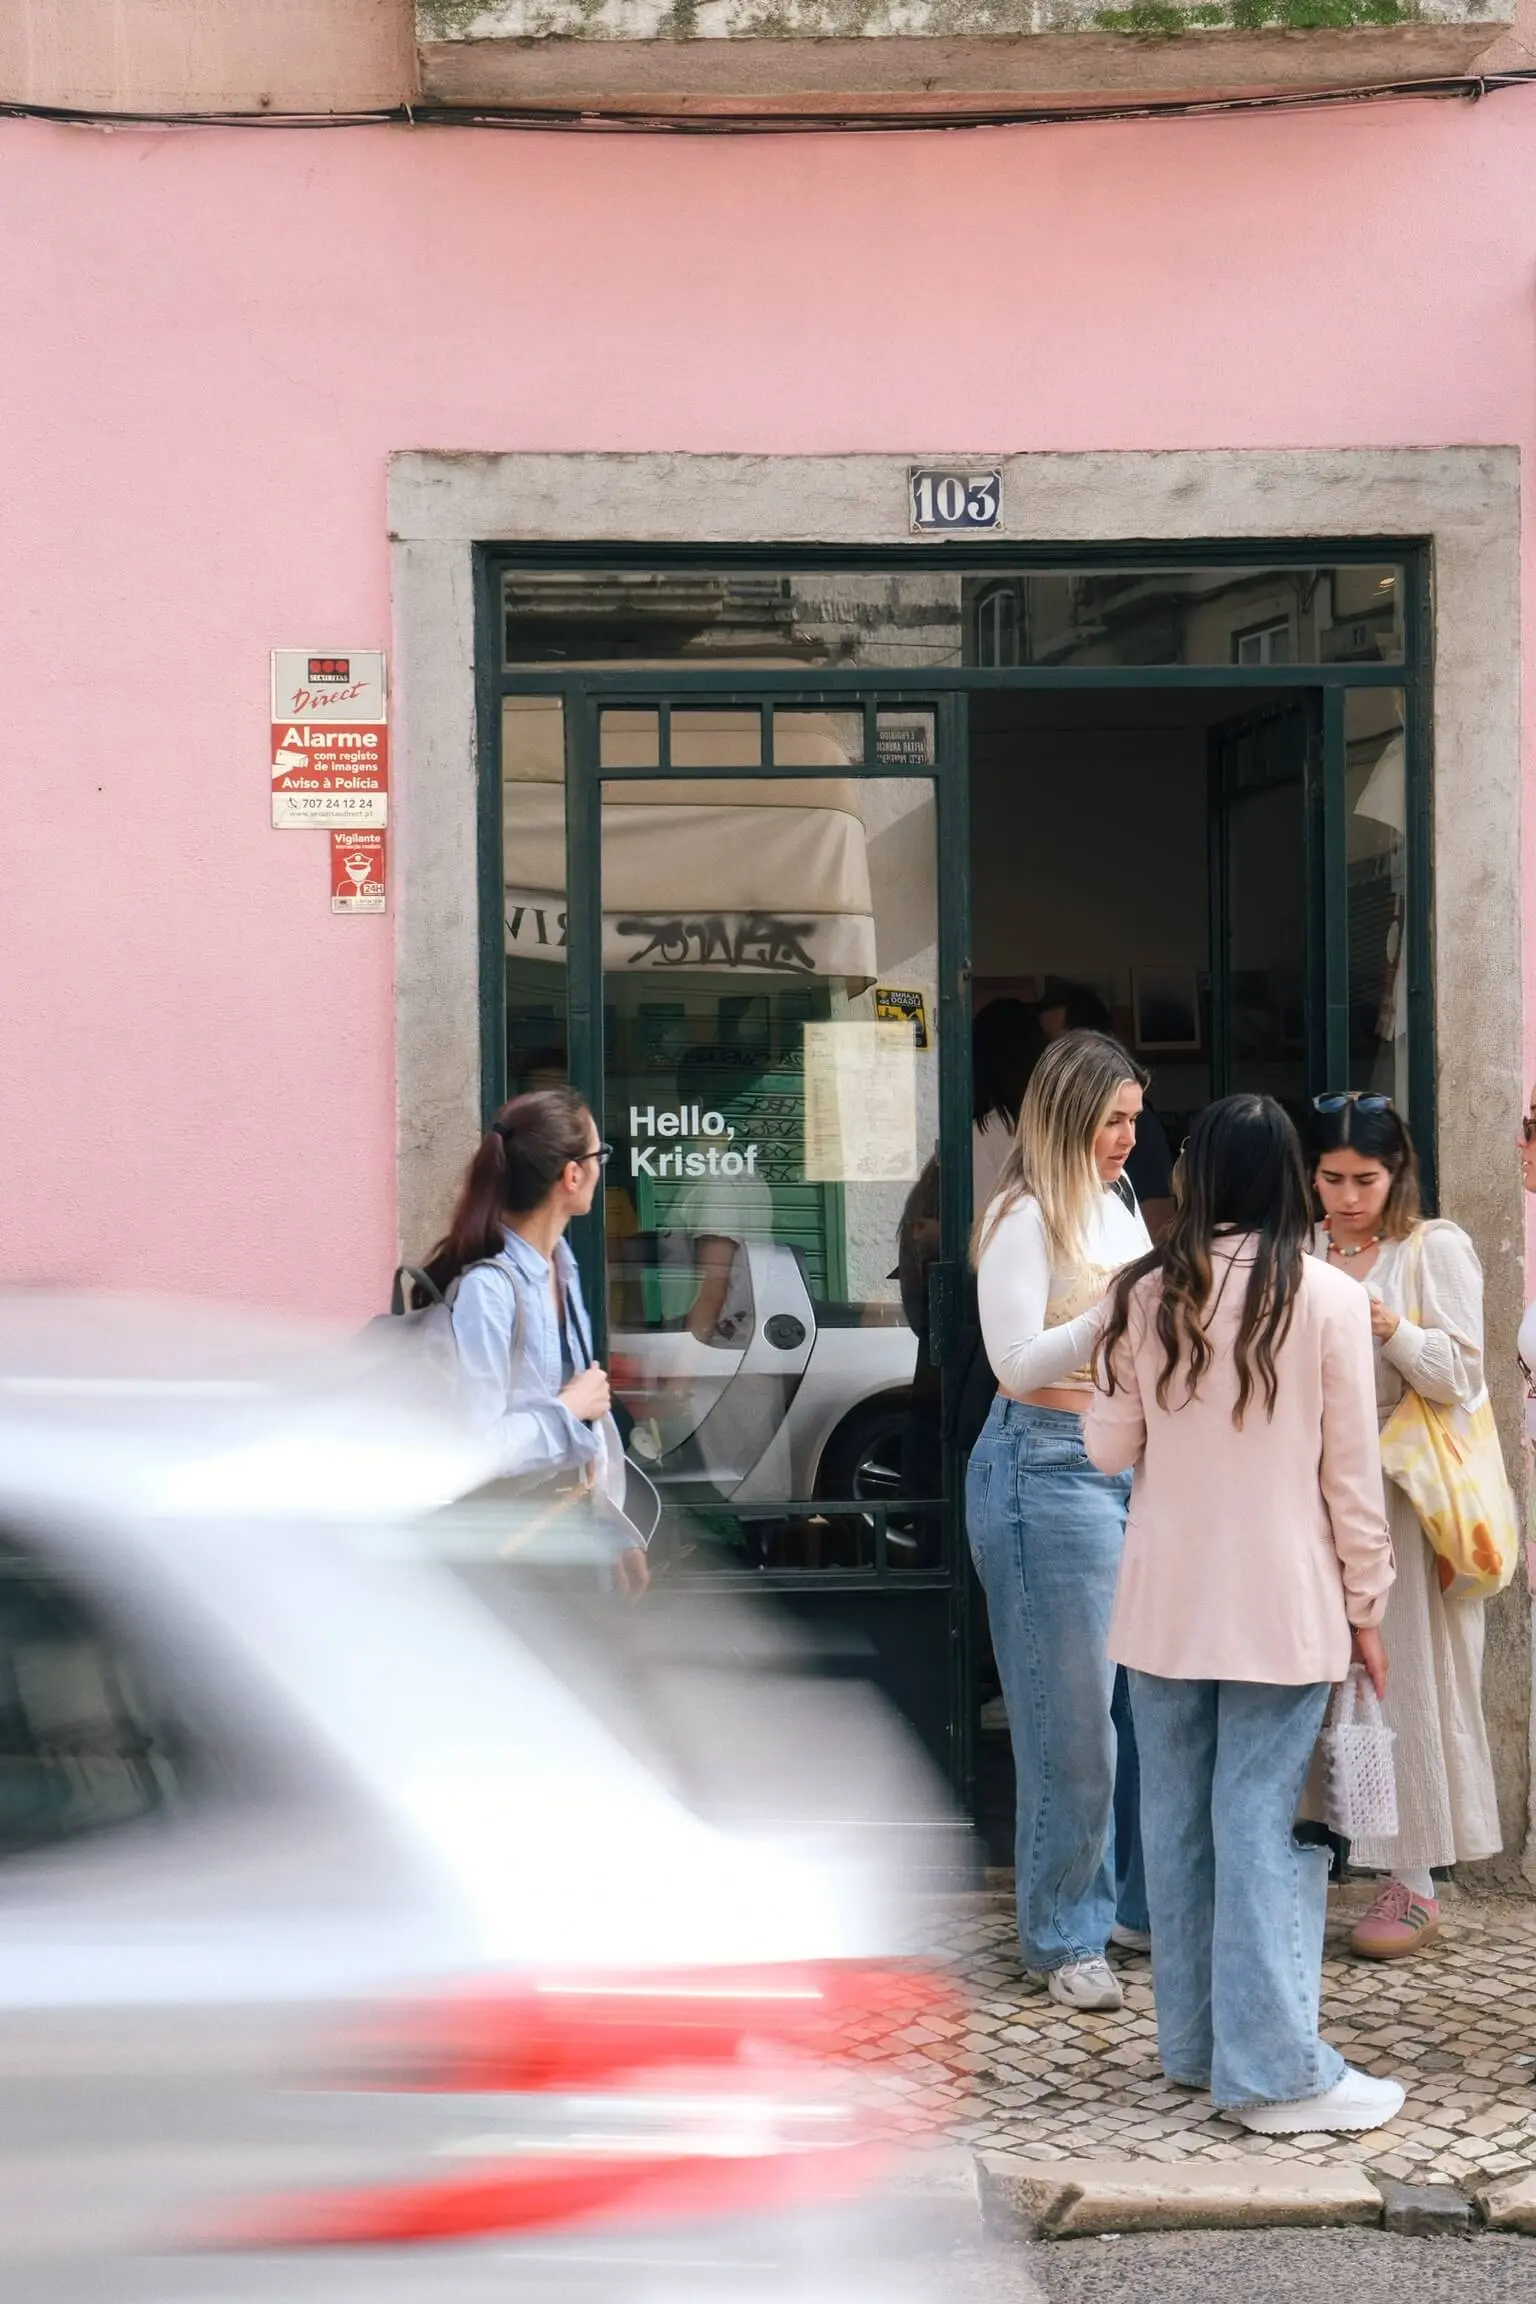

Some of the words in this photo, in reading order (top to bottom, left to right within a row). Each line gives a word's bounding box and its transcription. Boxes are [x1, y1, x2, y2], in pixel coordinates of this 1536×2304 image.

[916, 476, 996, 522] 103
[290, 681, 371, 714] Direct
[282, 726, 378, 748] Alarme
[313, 752, 337, 761] com
[339, 750, 378, 763] registo
[314, 761, 329, 771] de
[331, 761, 378, 774] imagens
[281, 777, 320, 789] Aviso
[323, 777, 332, 789] à
[335, 777, 379, 789] Polícia
[302, 799, 323, 809] 707
[326, 799, 340, 809] 24
[343, 799, 356, 809] 12
[359, 799, 373, 809] 24
[334, 834, 381, 845] Vigilante
[365, 884, 383, 893] 24H
[629, 1105, 735, 1140] Hello,
[630, 1145, 759, 1177] Kristof
